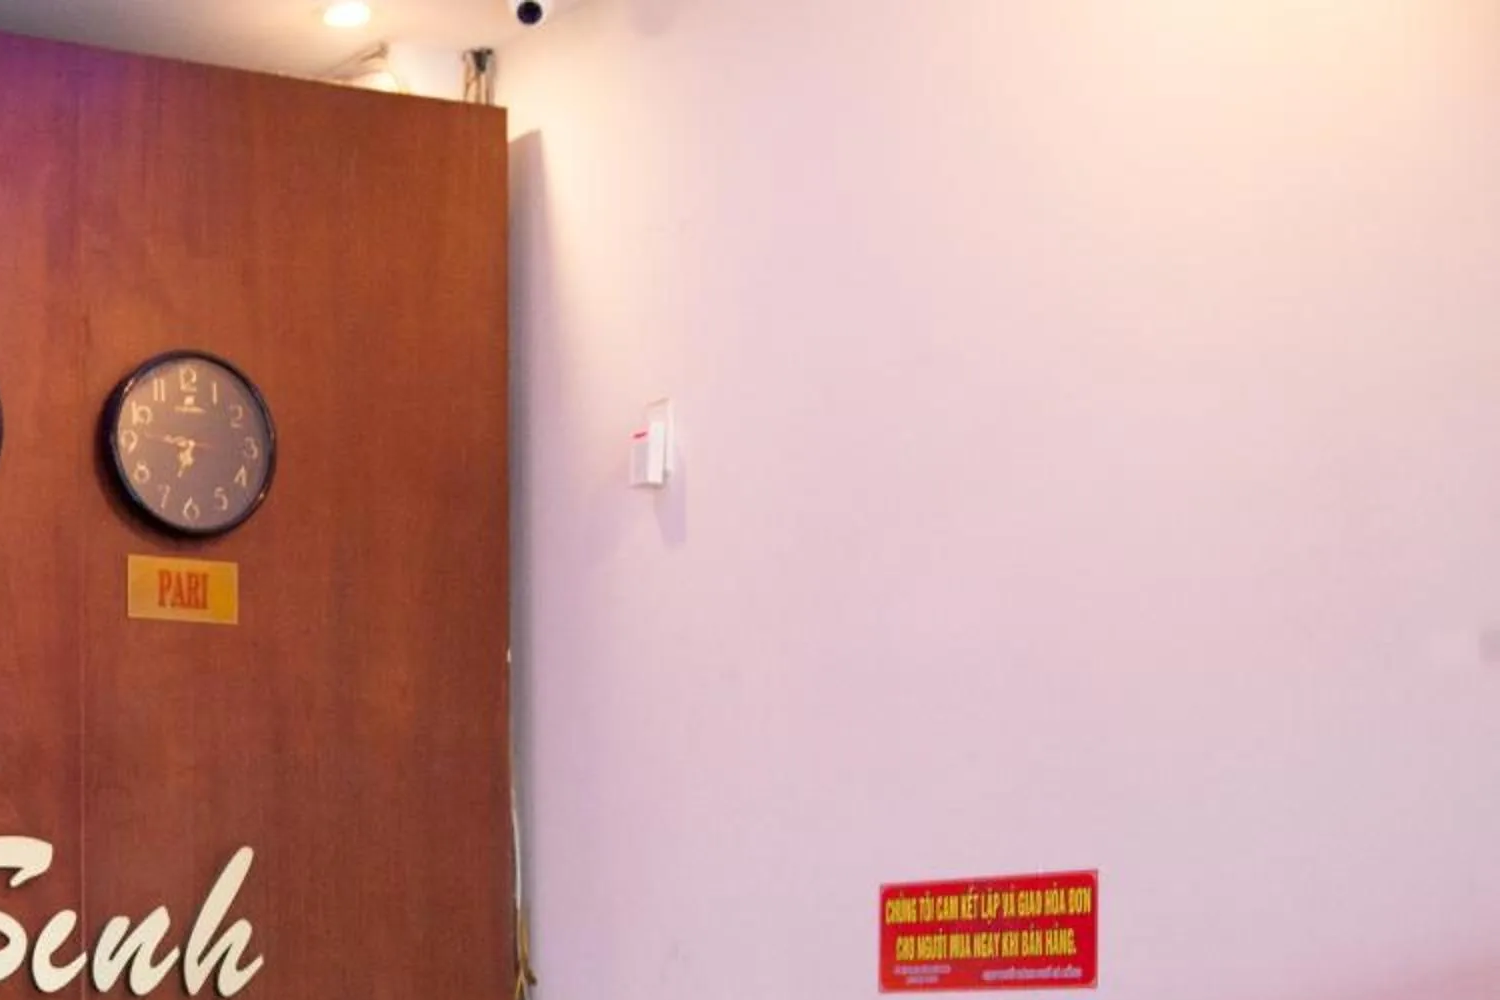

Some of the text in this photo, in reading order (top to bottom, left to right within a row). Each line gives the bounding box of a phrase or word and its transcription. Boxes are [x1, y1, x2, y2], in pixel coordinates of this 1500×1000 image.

[154, 379, 165, 402] 11
[180, 368, 197, 392] 12
[132, 400, 151, 425] 10
[230, 404, 242, 428] 2
[121, 430, 137, 455] 9
[244, 437, 258, 459] 3
[134, 460, 149, 483] 8
[234, 465, 246, 487] 4
[158, 485, 170, 509] 7
[183, 496, 199, 520] 6
[215, 487, 228, 510] 5
[157, 569, 209, 610] PARI
